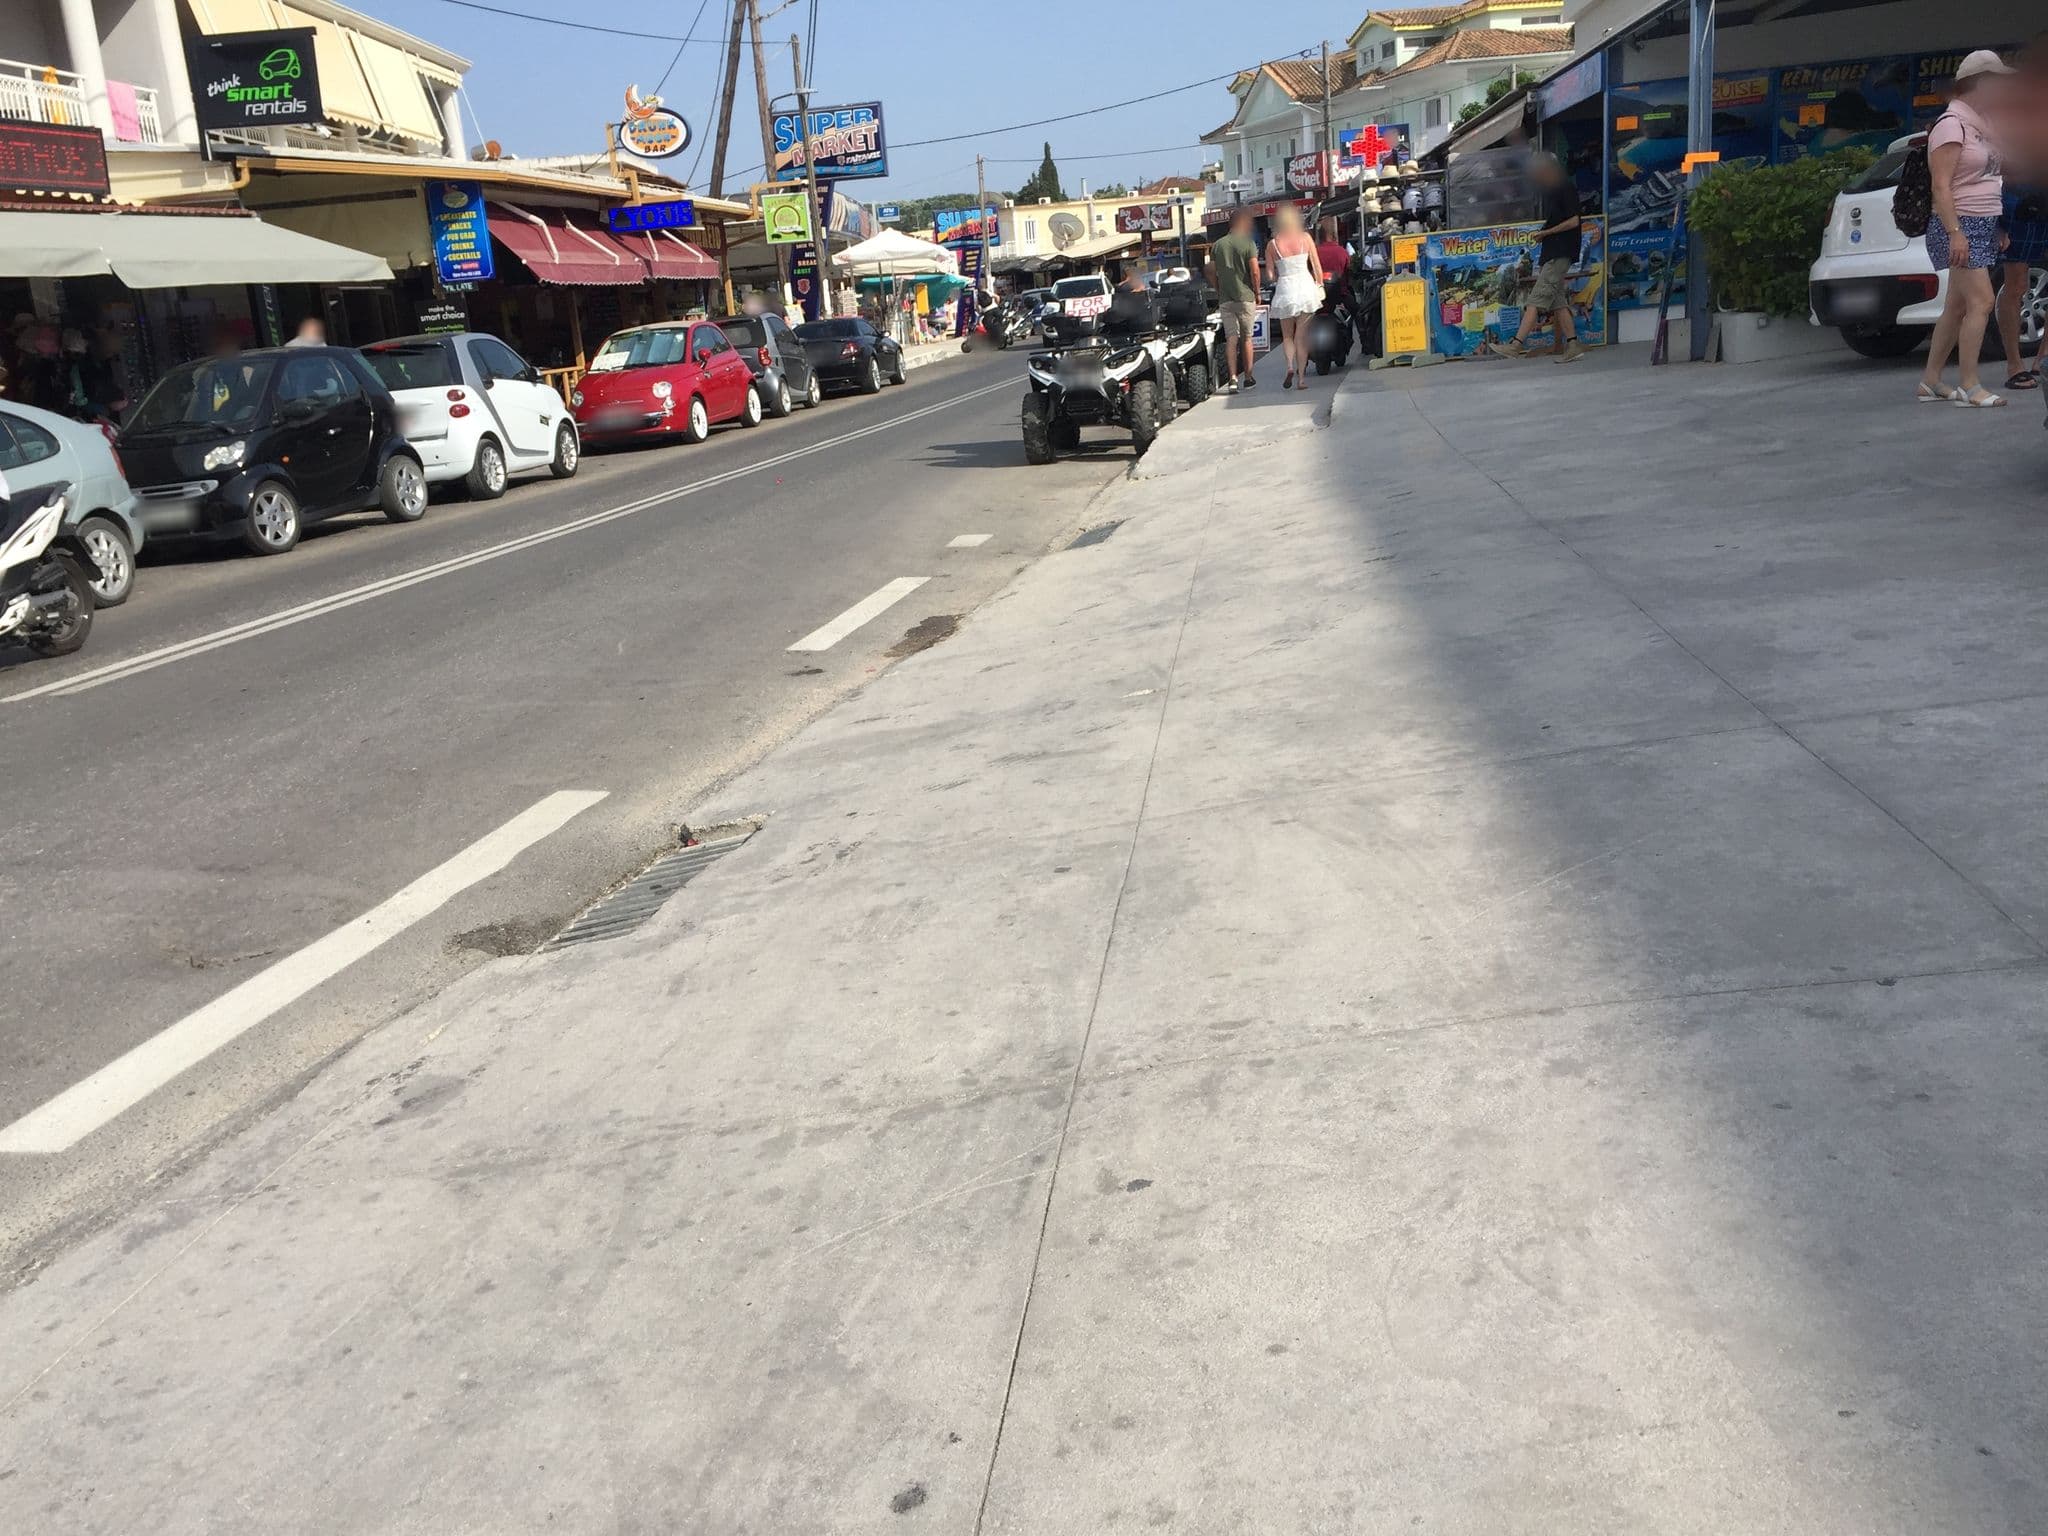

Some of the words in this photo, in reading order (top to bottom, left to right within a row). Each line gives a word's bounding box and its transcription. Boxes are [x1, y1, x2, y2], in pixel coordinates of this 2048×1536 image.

[206, 73, 241, 97] think
[1782, 70, 1817, 87] KERI
[226, 82, 293, 102] smart
[244, 97, 308, 116] rentals
[774, 107, 873, 152] SUPER
[644, 145, 667, 154] BAR
[791, 125, 878, 167] MARKET
[1288, 154, 1317, 174] Super
[1287, 169, 1321, 187] Market
[947, 216, 997, 241] MARKT
[1440, 236, 1490, 256] Water
[1490, 226, 1539, 249] Villag
[1066, 304, 1110, 317] RENT
[1072, 296, 1104, 309] FOR
[442, 311, 465, 320] choice
